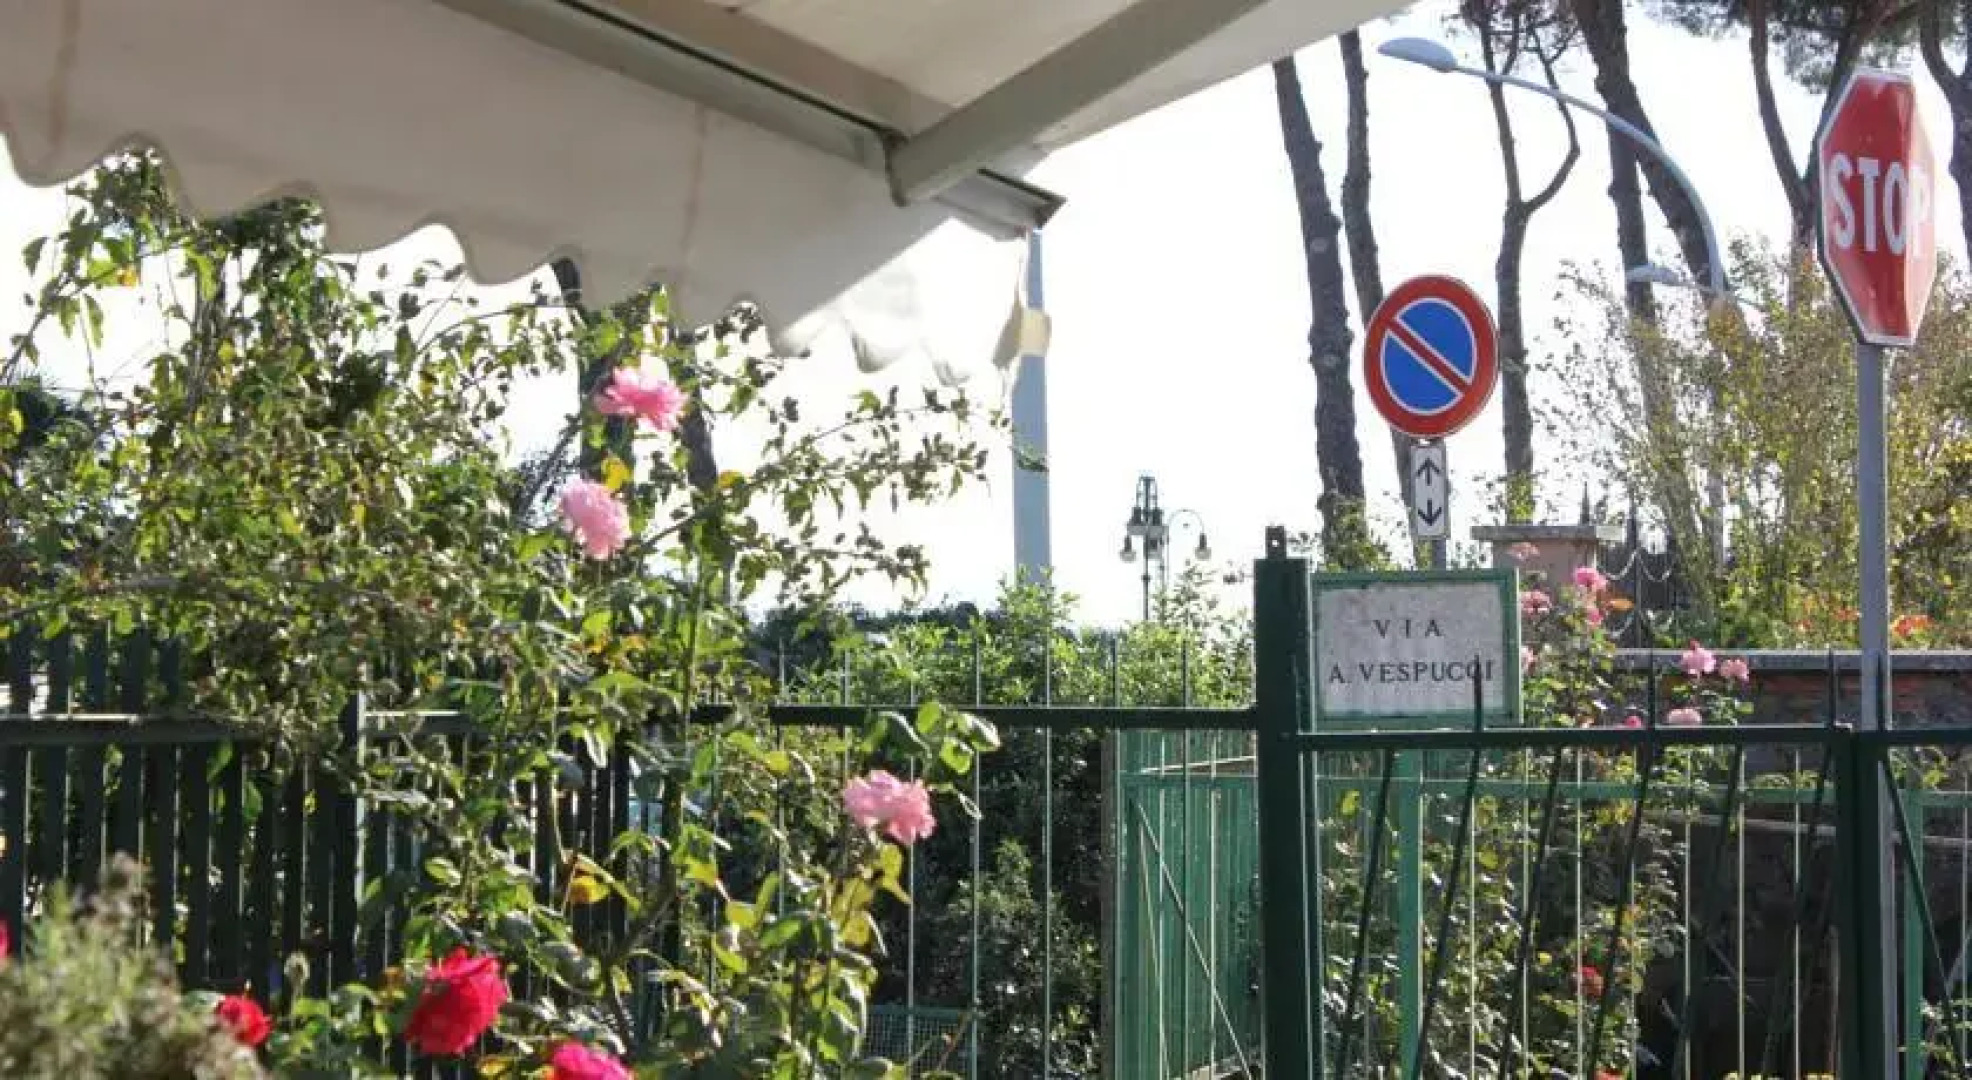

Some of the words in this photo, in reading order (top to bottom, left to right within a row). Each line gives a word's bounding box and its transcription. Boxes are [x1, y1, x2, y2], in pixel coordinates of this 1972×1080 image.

[1829, 152, 1931, 257] STOP
[1373, 619, 1442, 638] VIA
[1329, 662, 1352, 683] A.
[1359, 660, 1494, 682] VESPUCCI
